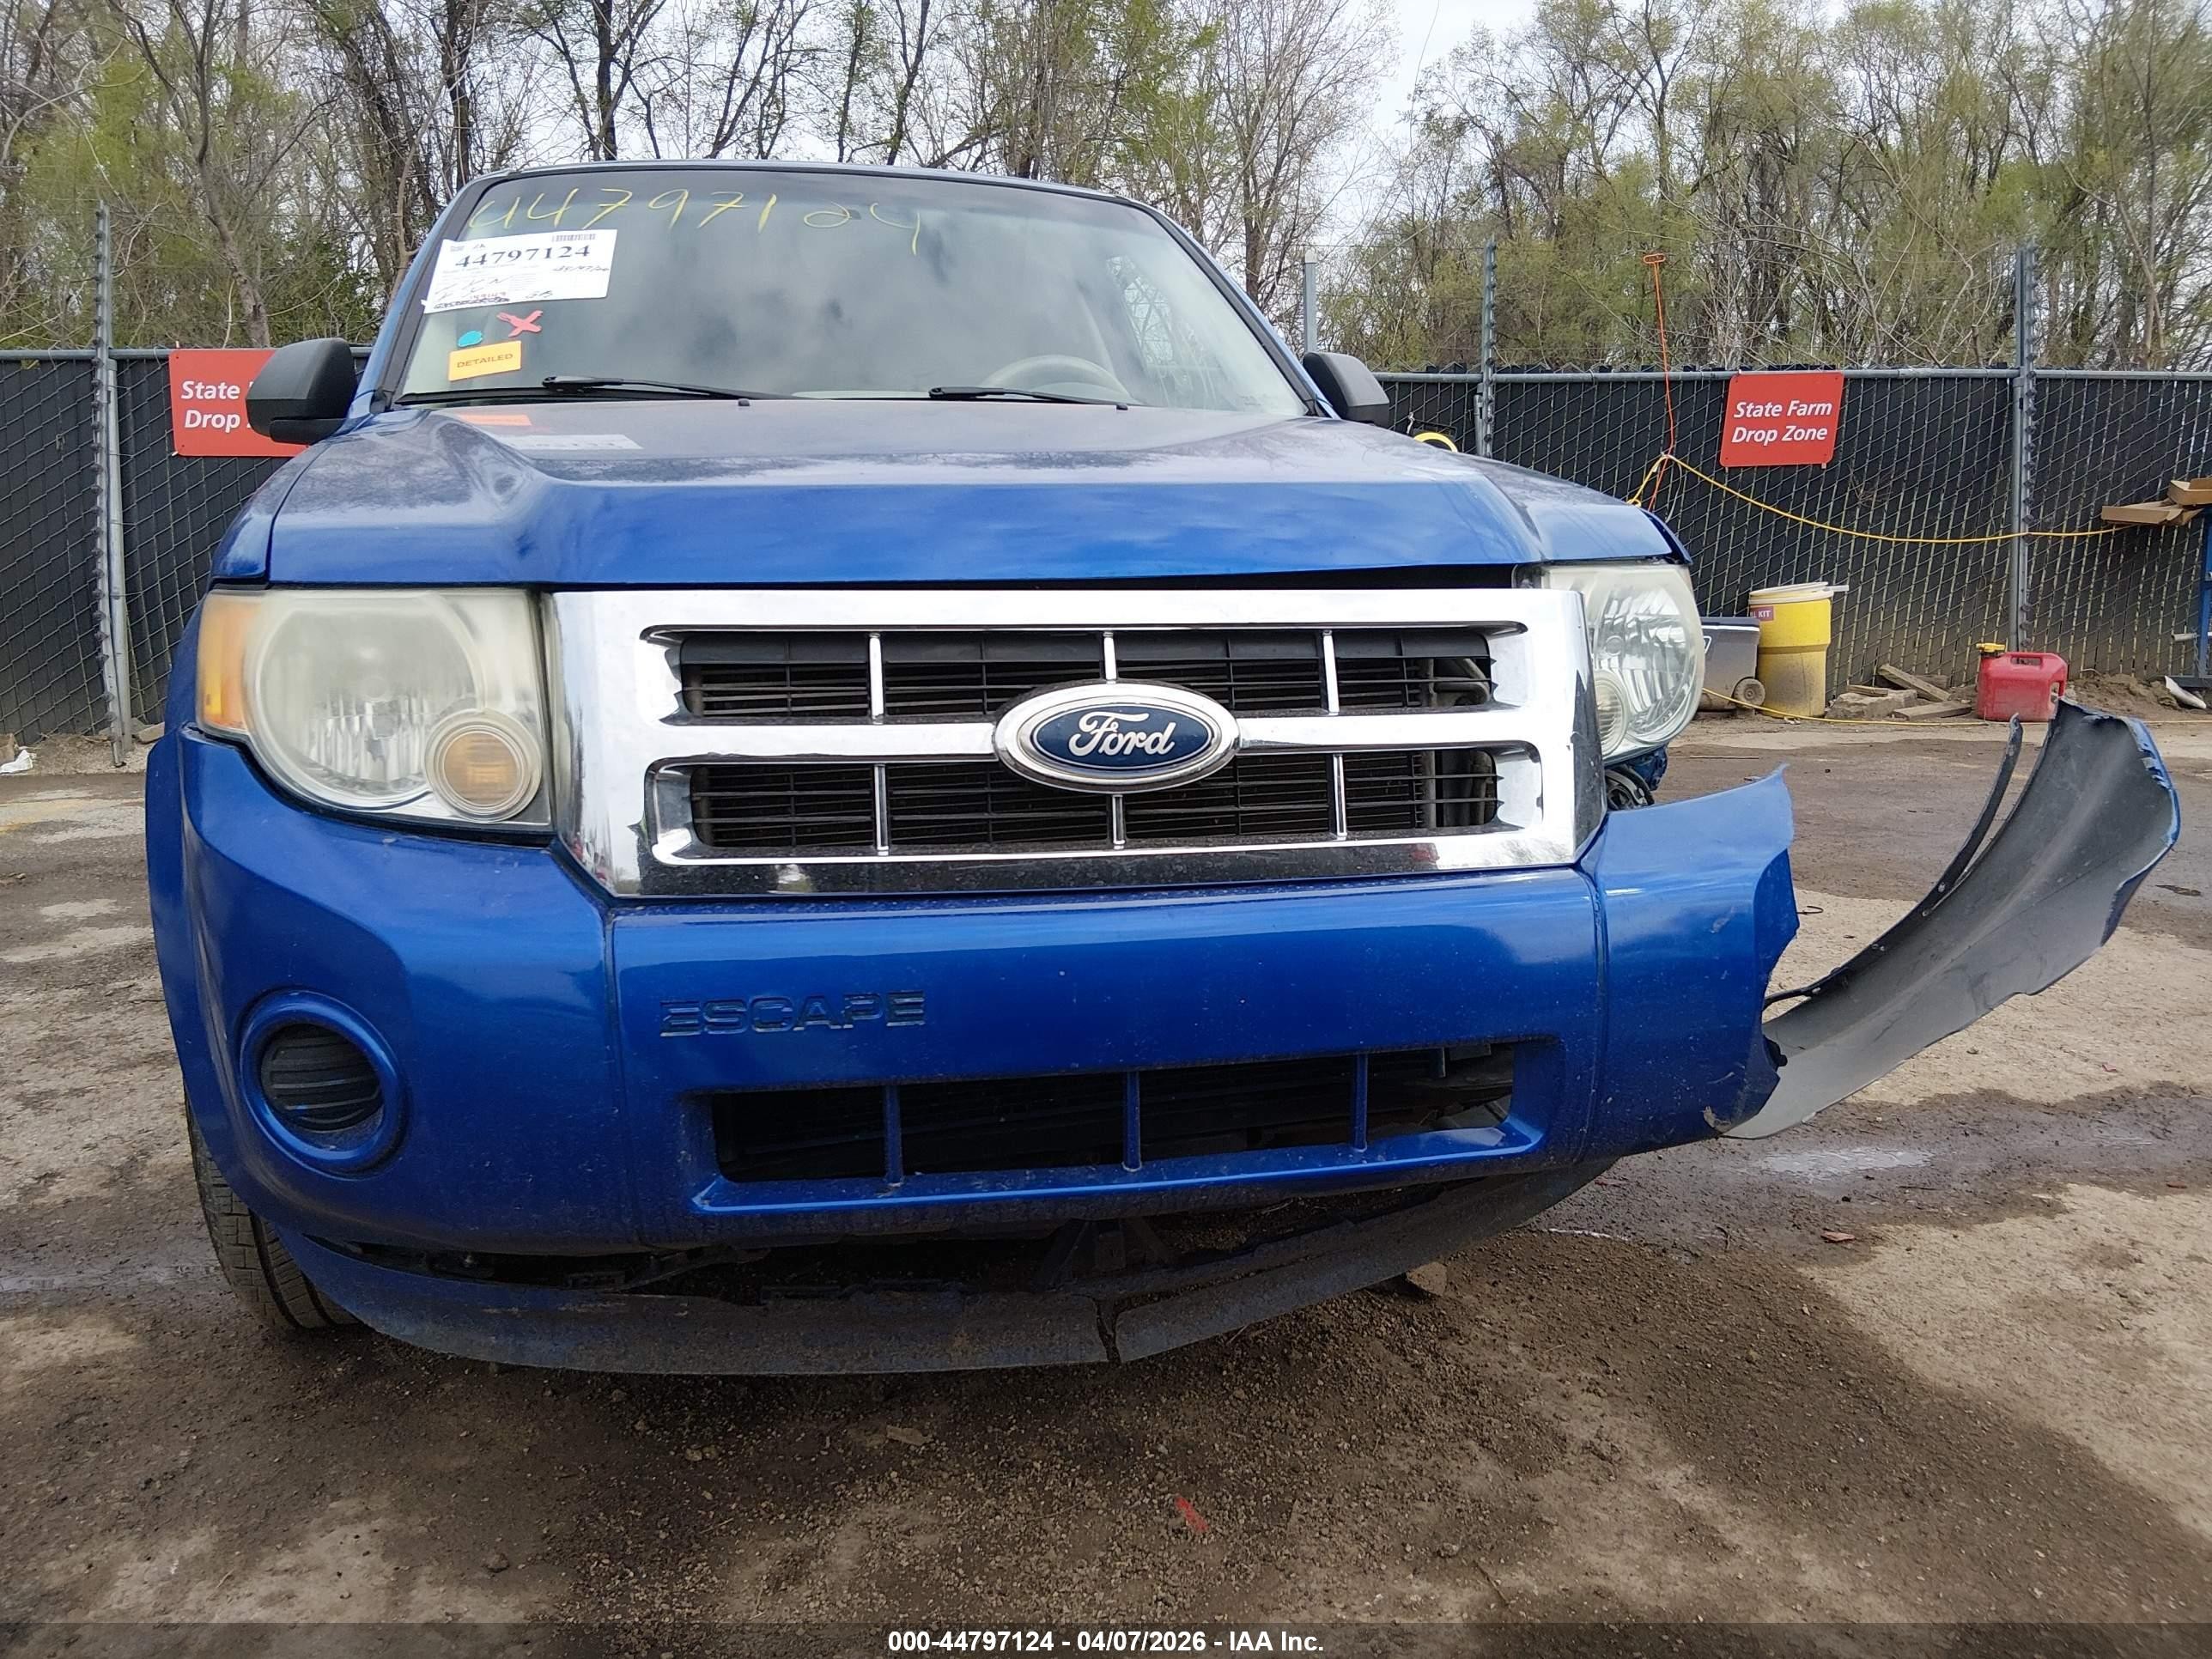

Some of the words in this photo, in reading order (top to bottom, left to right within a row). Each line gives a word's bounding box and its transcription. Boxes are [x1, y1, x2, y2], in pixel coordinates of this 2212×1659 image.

[455, 245, 590, 268] 44797124
[456, 352, 514, 369] DETAILED
[180, 380, 240, 399] State
[1733, 401, 1783, 418] State
[1786, 400, 1832, 416] Farm
[185, 410, 240, 433] Drop
[1731, 427, 1778, 446] Drop
[1782, 425, 1828, 441] Zone
[1758, 610, 1771, 618] KIT
[1068, 711, 1176, 757] Ford
[659, 989, 927, 1037] ESCAPE
